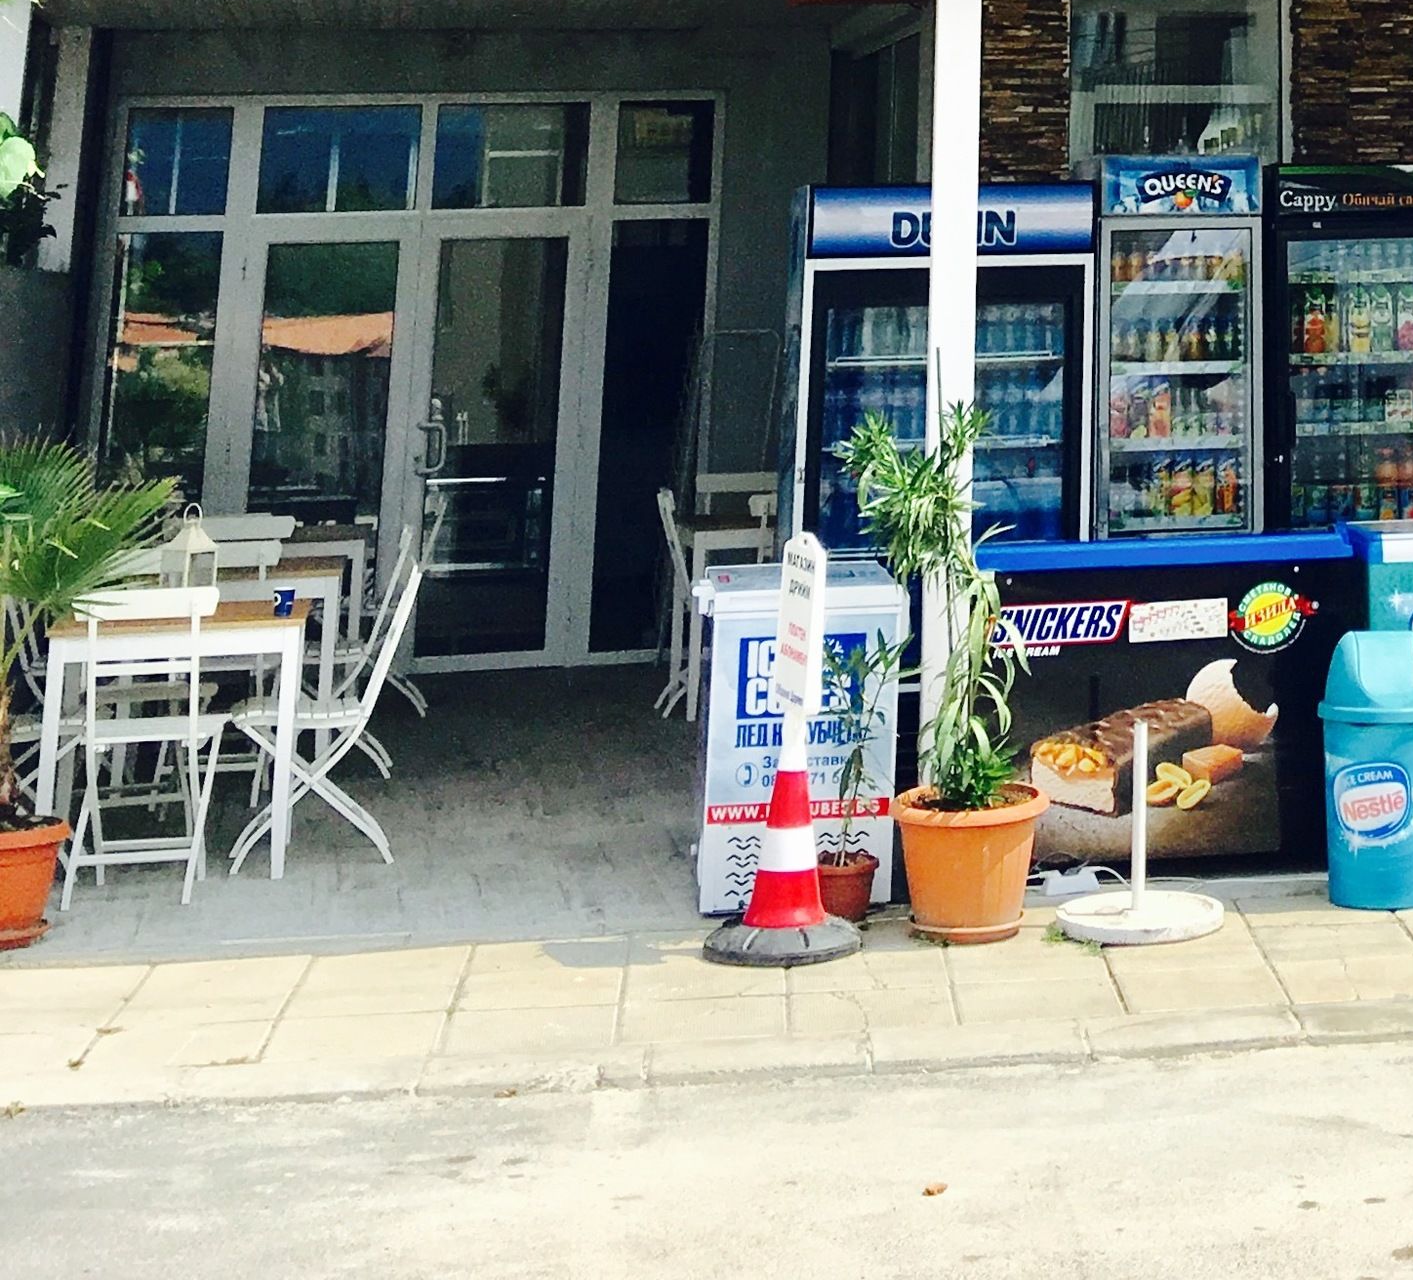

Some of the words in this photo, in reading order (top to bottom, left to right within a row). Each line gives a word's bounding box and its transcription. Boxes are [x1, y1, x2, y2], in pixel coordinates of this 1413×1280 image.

[1144, 173, 1224, 196] QUEEN'S
[1279, 190, 1336, 211] Cappy
[1238, 582, 1292, 612] СМЕТАНОВ
[992, 604, 1123, 642] SNICKERS
[735, 723, 768, 748] ЛЕД
[1358, 770, 1393, 783] CREAM
